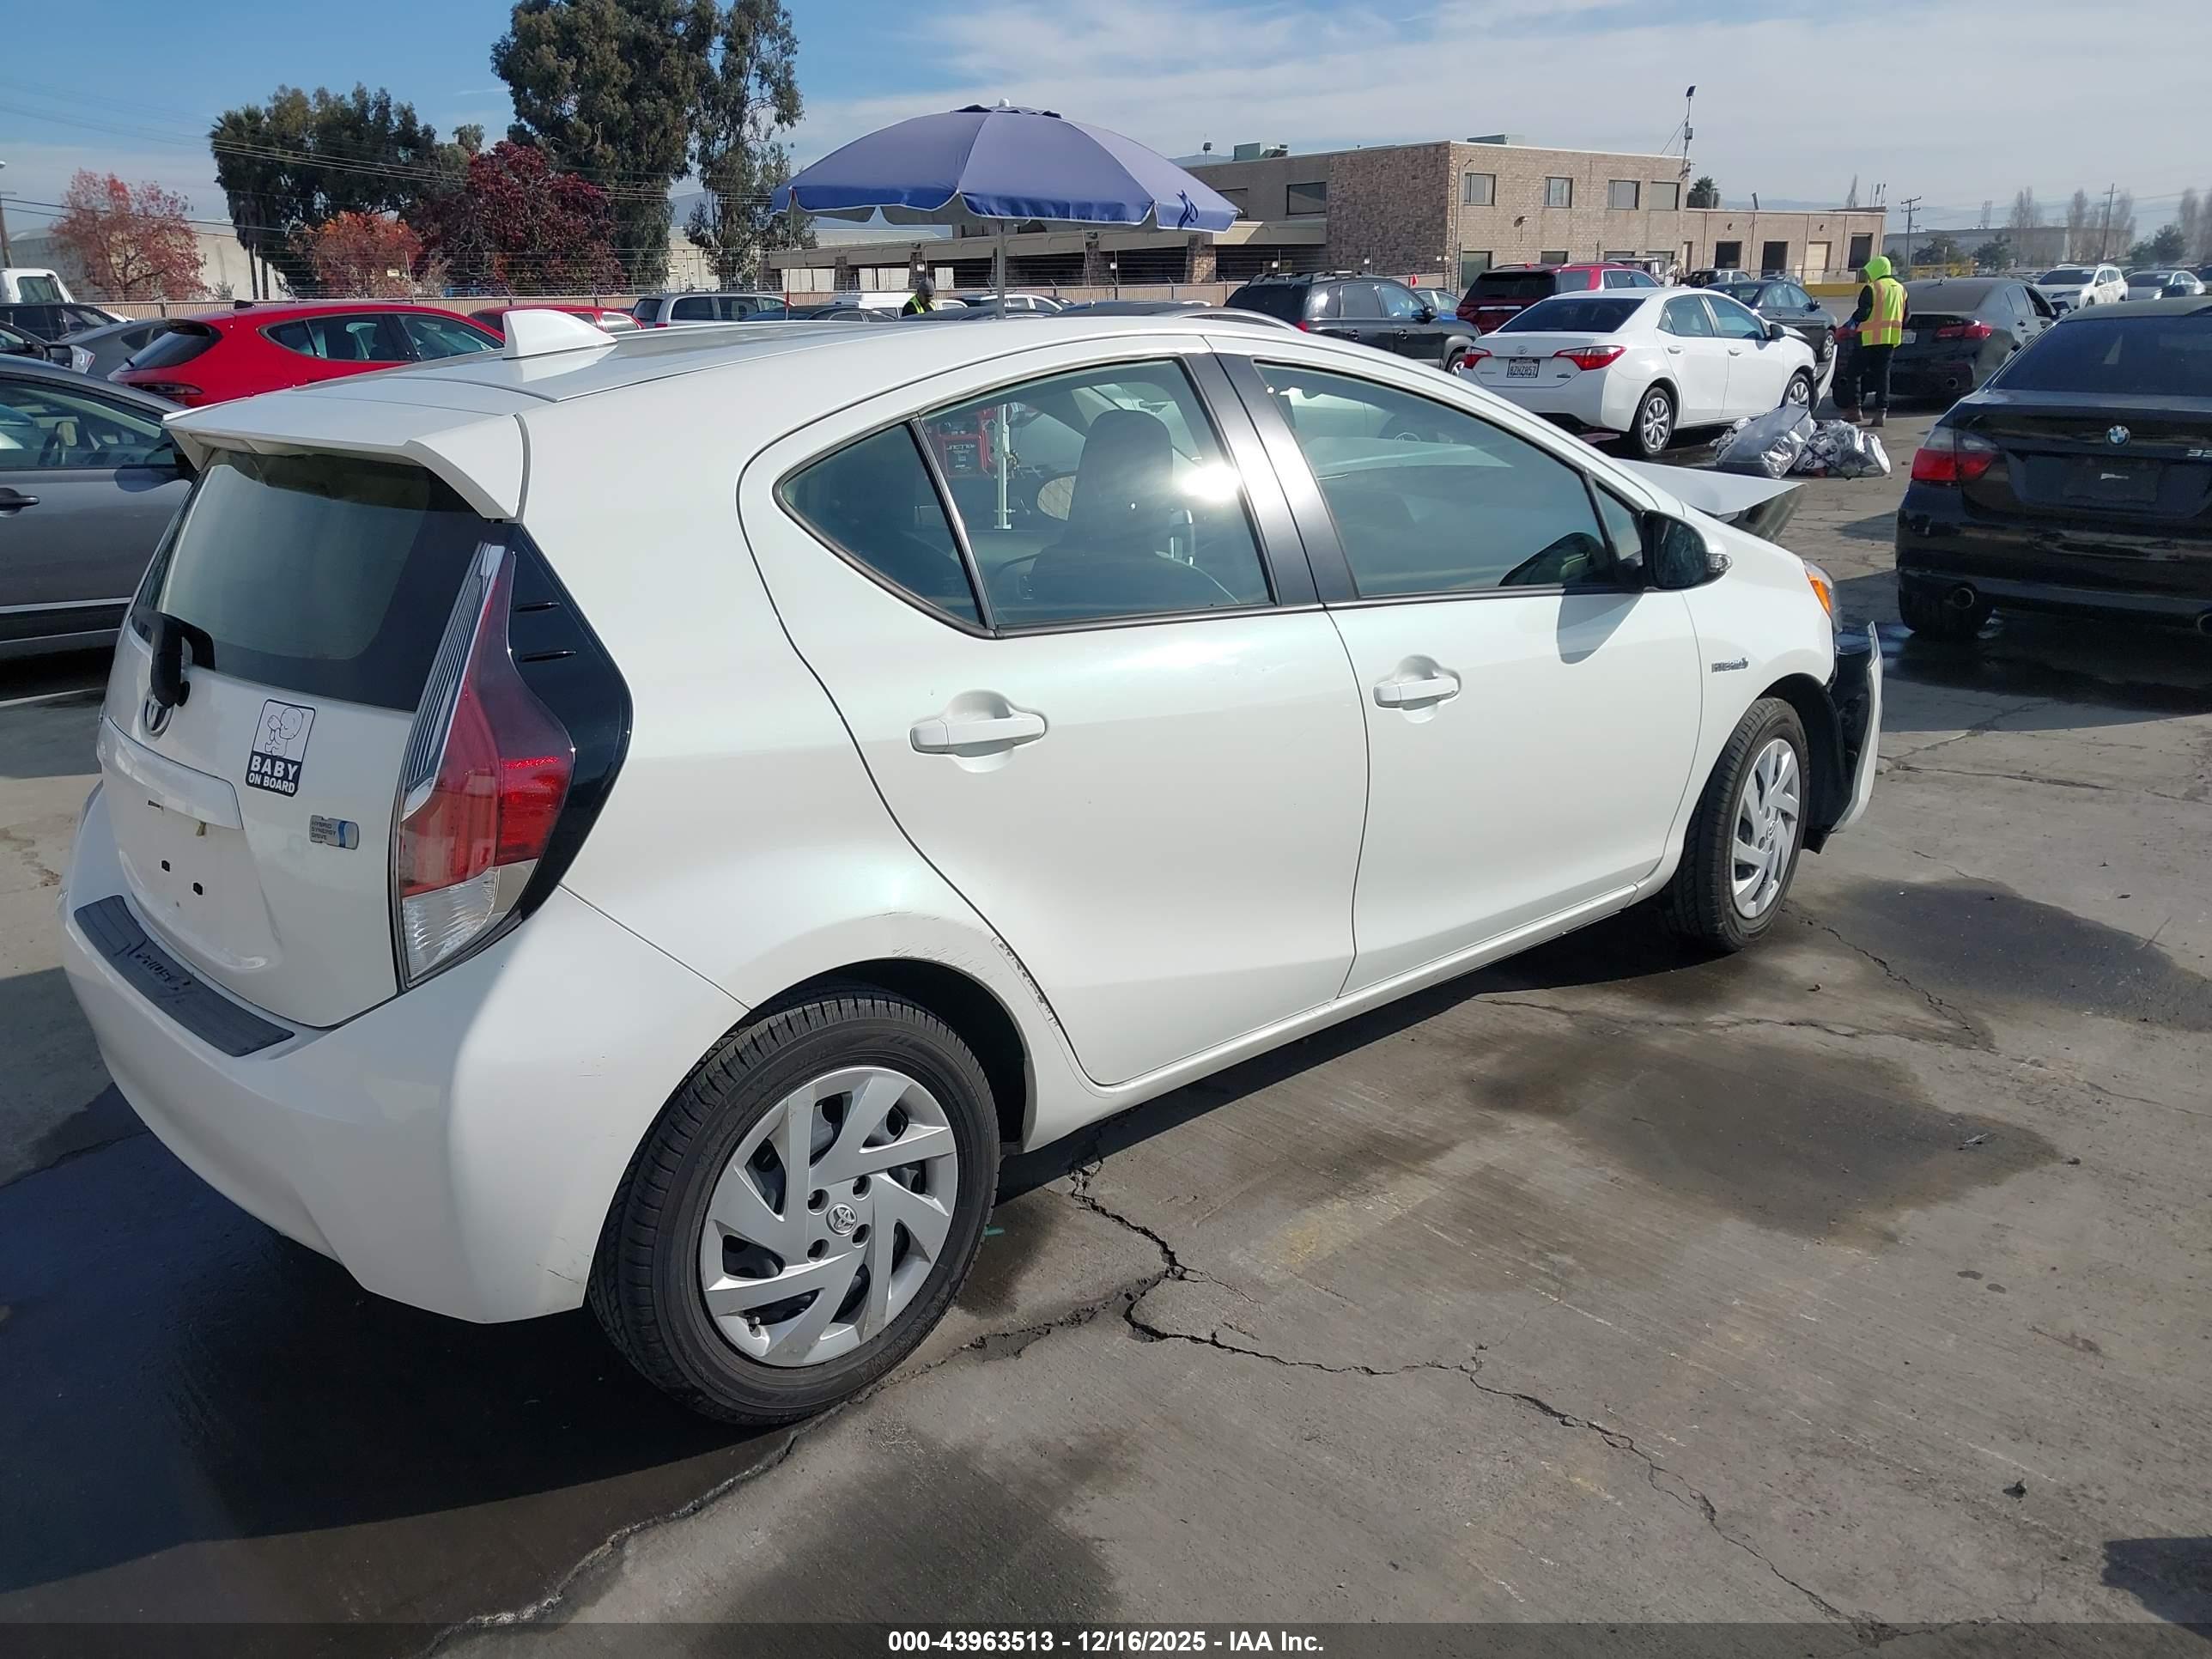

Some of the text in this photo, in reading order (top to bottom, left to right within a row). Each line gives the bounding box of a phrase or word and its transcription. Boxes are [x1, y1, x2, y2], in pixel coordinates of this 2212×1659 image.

[250, 755, 299, 781] BABY
[248, 772, 295, 793] ON BOARD
